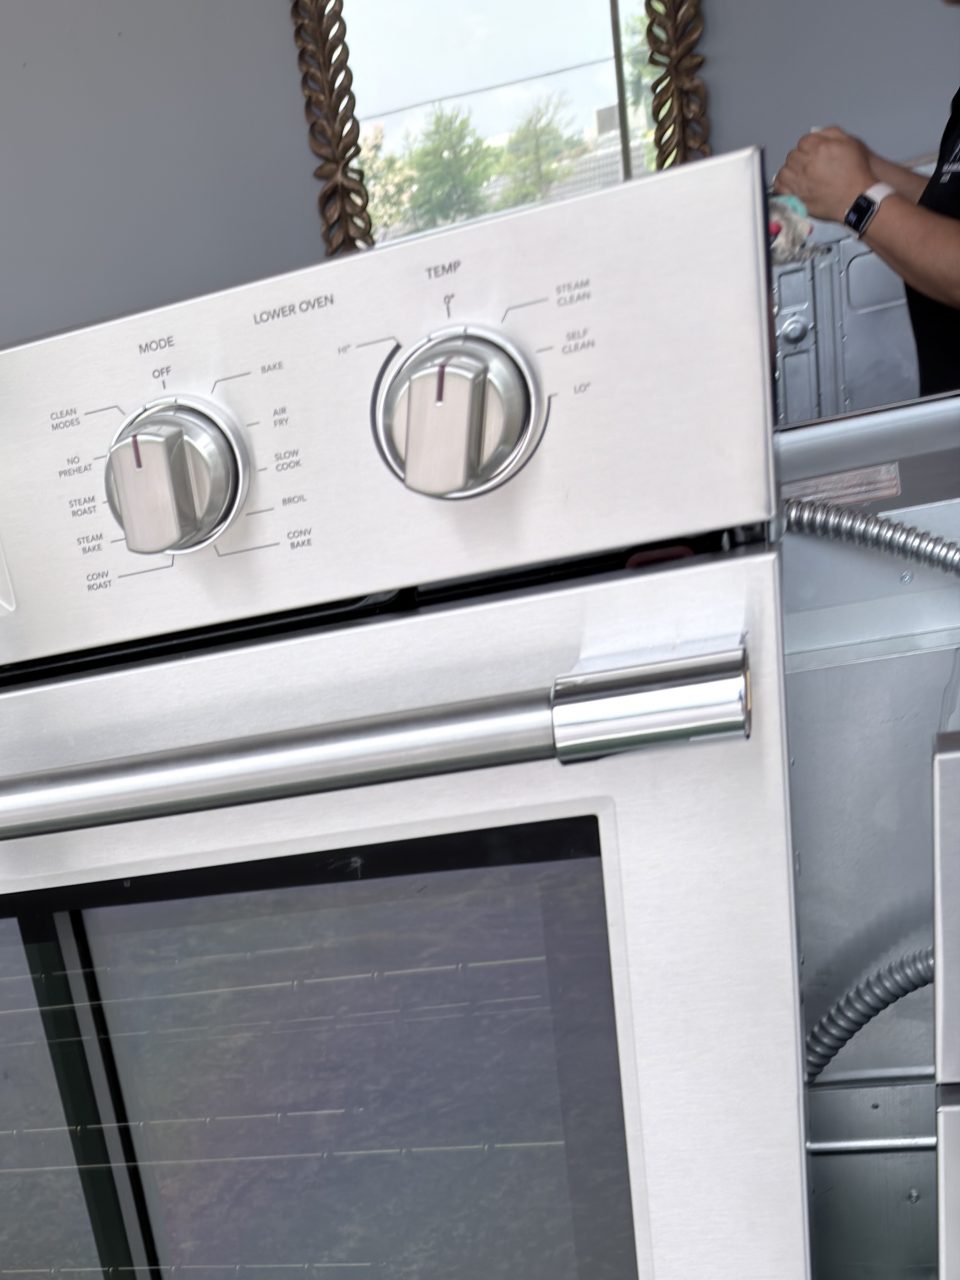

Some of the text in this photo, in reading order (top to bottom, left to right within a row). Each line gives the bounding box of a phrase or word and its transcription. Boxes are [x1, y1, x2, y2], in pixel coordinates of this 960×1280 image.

[425, 260, 461, 280] TEMP
[556, 279, 590, 294] STEAM
[557, 291, 591, 307] CLEAN
[254, 294, 334, 325] LOWER OVEN
[566, 329, 588, 341] SELF
[139, 336, 175, 354] MODE
[562, 339, 595, 355] CLEAN
[152, 367, 172, 379] OFF
[261, 362, 283, 374] BAKE
[50, 408, 77, 421] CLEAN
[273, 407, 287, 417] AIR
[51, 418, 81, 431] MODES
[273, 417, 289, 428] FRY
[67, 456, 80, 466] NO
[274, 449, 299, 461] SLOW
[58, 464, 93, 479] PREHEAT
[276, 459, 302, 472] COOK
[69, 496, 96, 508] STEAM
[282, 494, 307, 506] BROIL
[71, 506, 97, 518] ROAST
[77, 533, 103, 545] STEAM
[287, 528, 312, 540] CONV
[82, 543, 103, 555] BAKE
[290, 538, 312, 550] BAKE
[86, 570, 109, 582] CONV
[87, 579, 112, 592] ROAST
